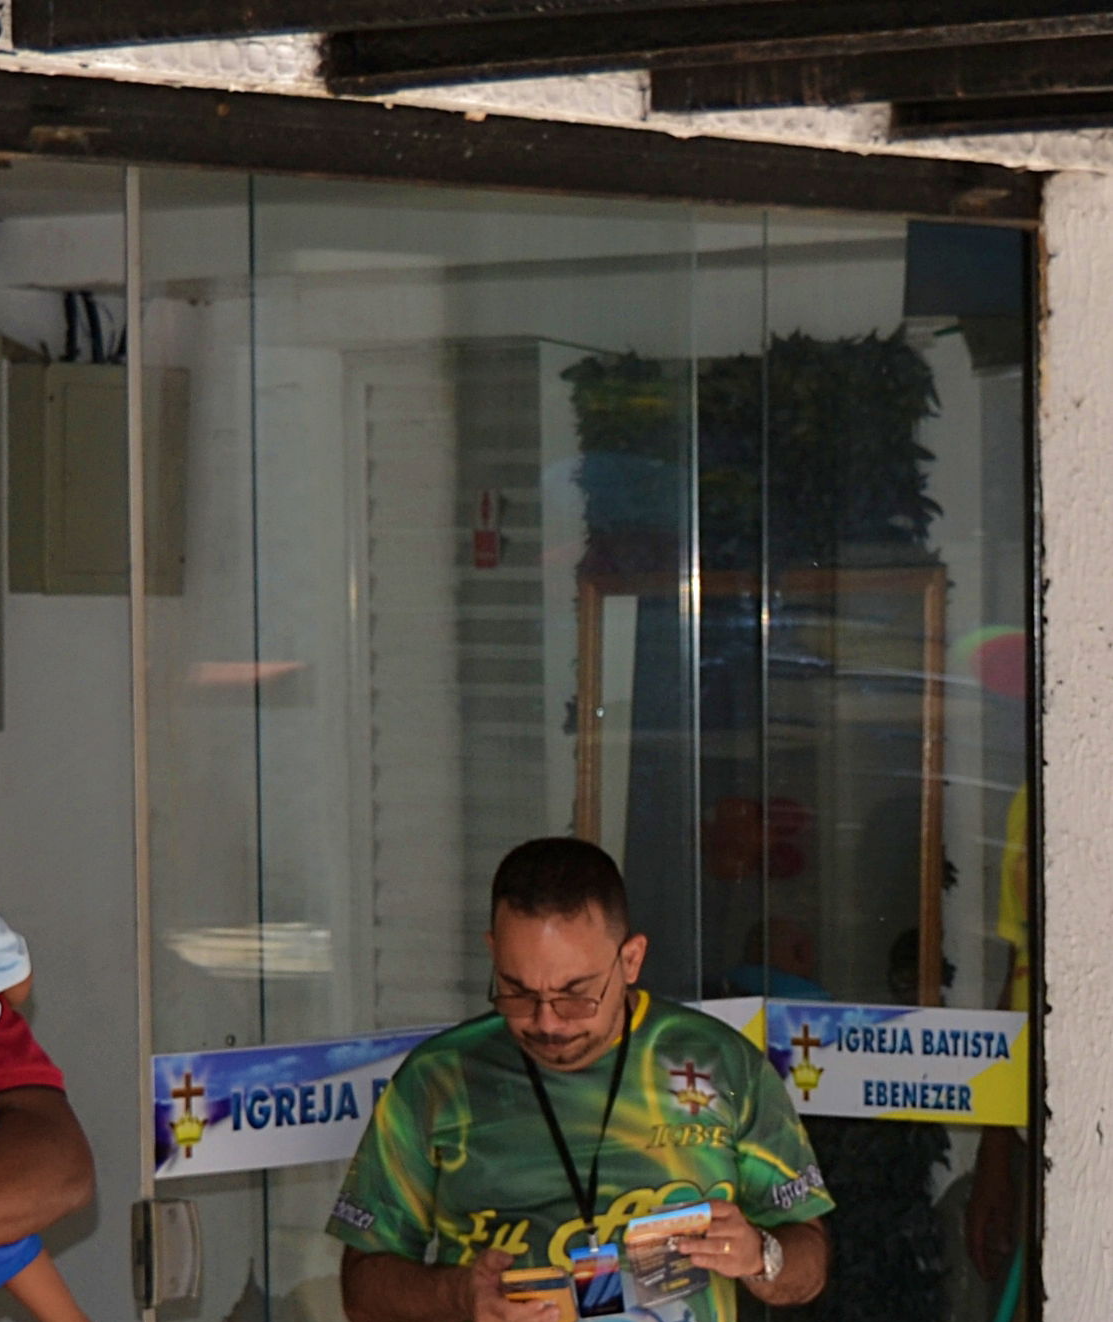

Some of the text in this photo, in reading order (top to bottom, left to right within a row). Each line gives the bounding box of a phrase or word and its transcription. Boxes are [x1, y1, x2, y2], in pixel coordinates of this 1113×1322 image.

[837, 1027, 1010, 1059] IGREJA BATISTA
[231, 1081, 359, 1131] IGREJA
[863, 1073, 972, 1111] EBENÉZER
